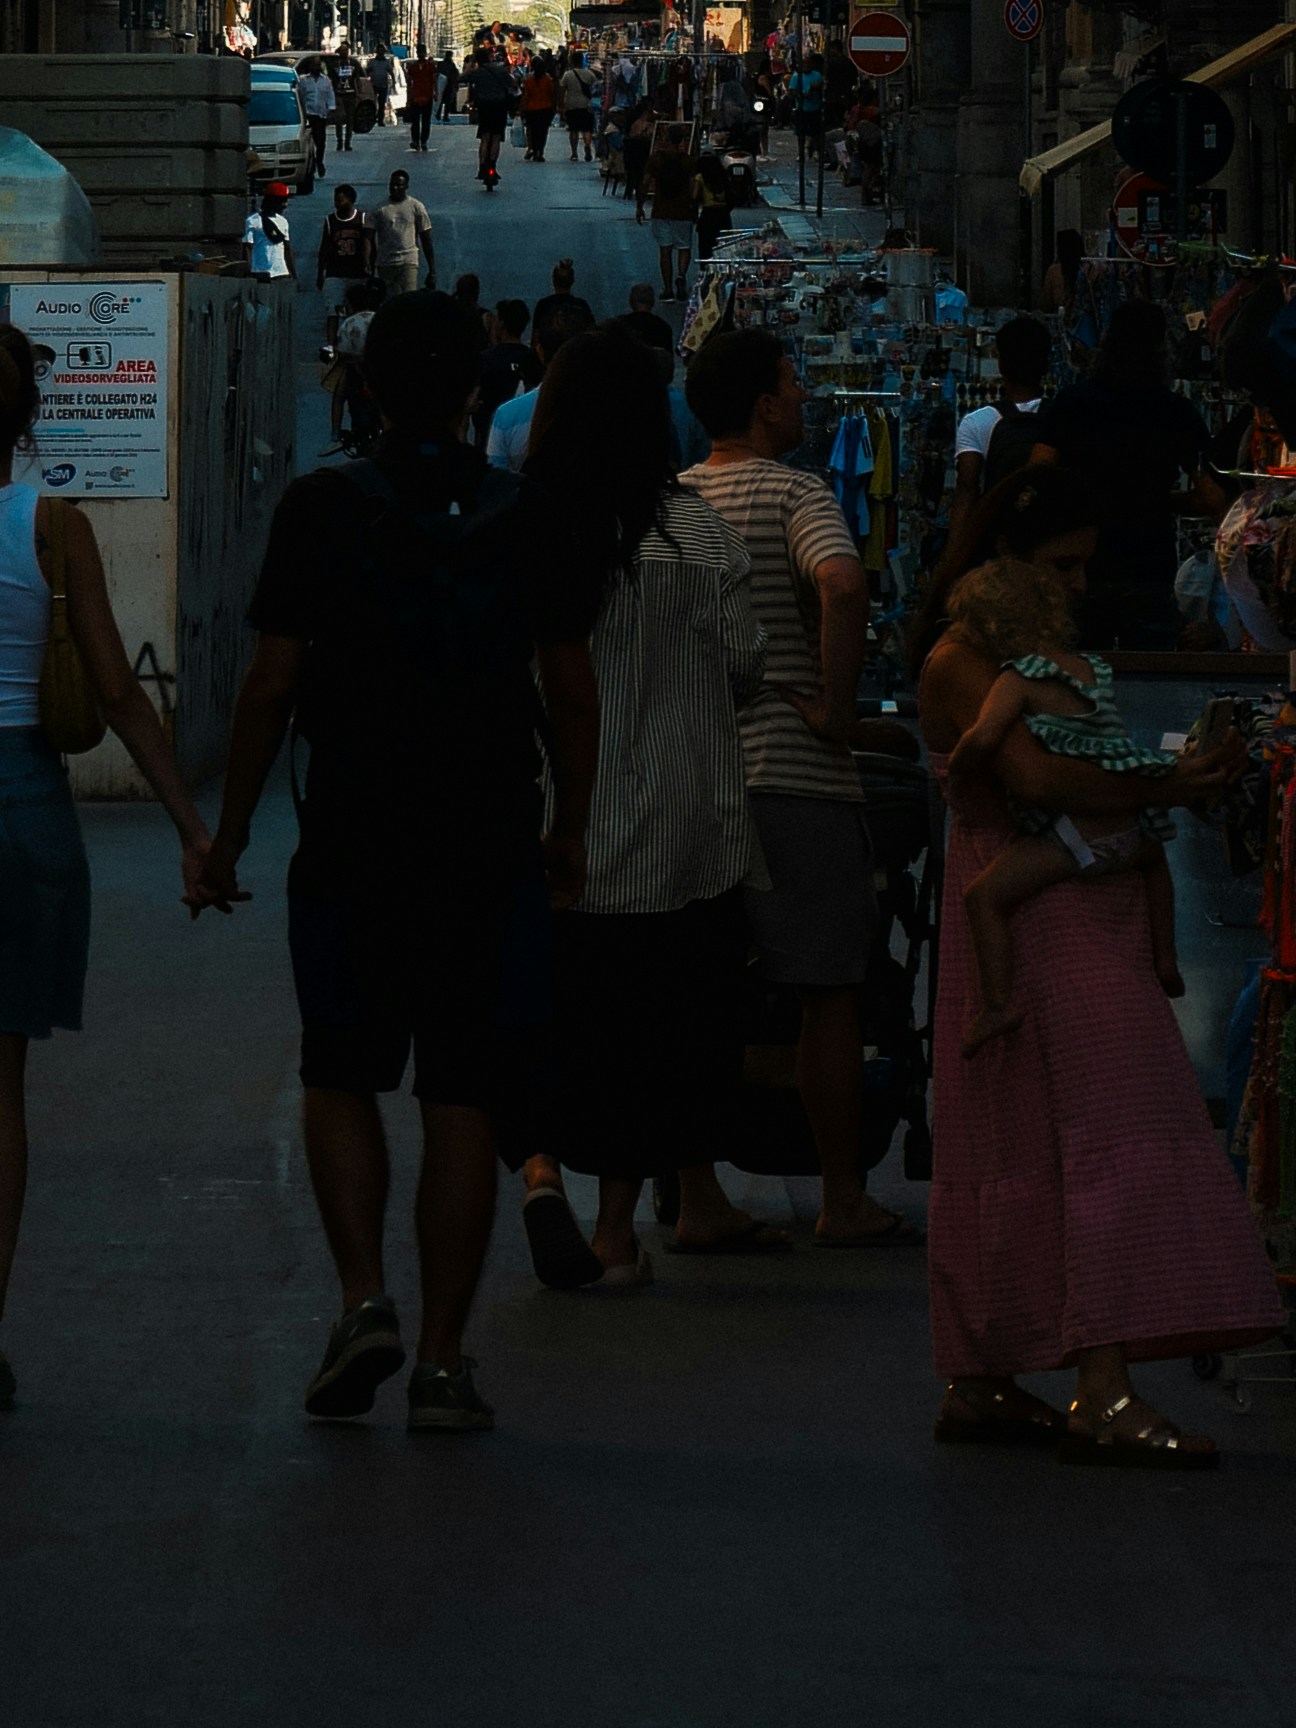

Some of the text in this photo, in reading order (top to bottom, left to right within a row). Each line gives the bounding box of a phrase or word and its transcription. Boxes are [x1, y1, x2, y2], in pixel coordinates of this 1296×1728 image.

[116, 360, 156, 372] AREA
[54, 374, 156, 383] VIDEOSORVEGLIATA
[37, 394, 75, 405] ANTIERE
[85, 394, 137, 405] COLLEGATO
[140, 394, 157, 405] H24
[42, 408, 155, 420] LA CENTRALE OPERATIVA
